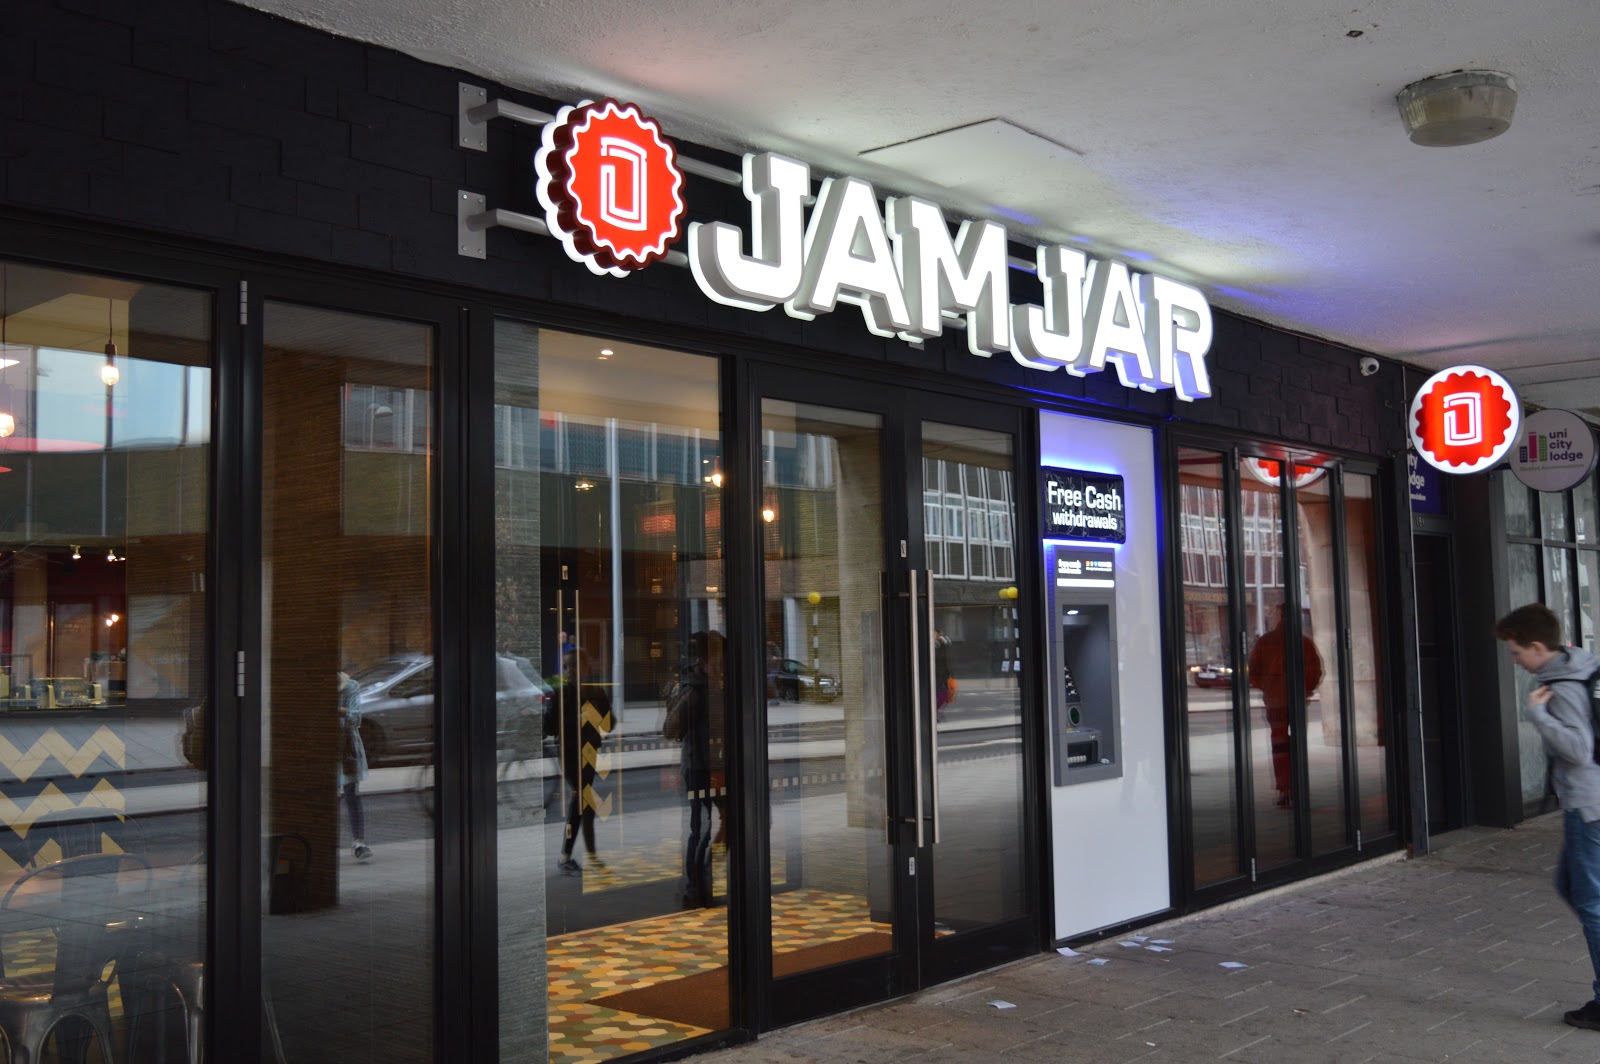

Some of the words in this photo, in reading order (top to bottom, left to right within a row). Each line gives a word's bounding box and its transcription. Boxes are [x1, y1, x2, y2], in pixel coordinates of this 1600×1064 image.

[689, 151, 1010, 356] JAM
[1009, 244, 1213, 402] JAR
[1549, 428, 1567, 439] uni
[1549, 440, 1573, 450] city
[1550, 451, 1584, 462] lodge
[1048, 481, 1082, 506] Free
[1085, 486, 1121, 511] Cash
[1052, 509, 1118, 530] withdrawals
